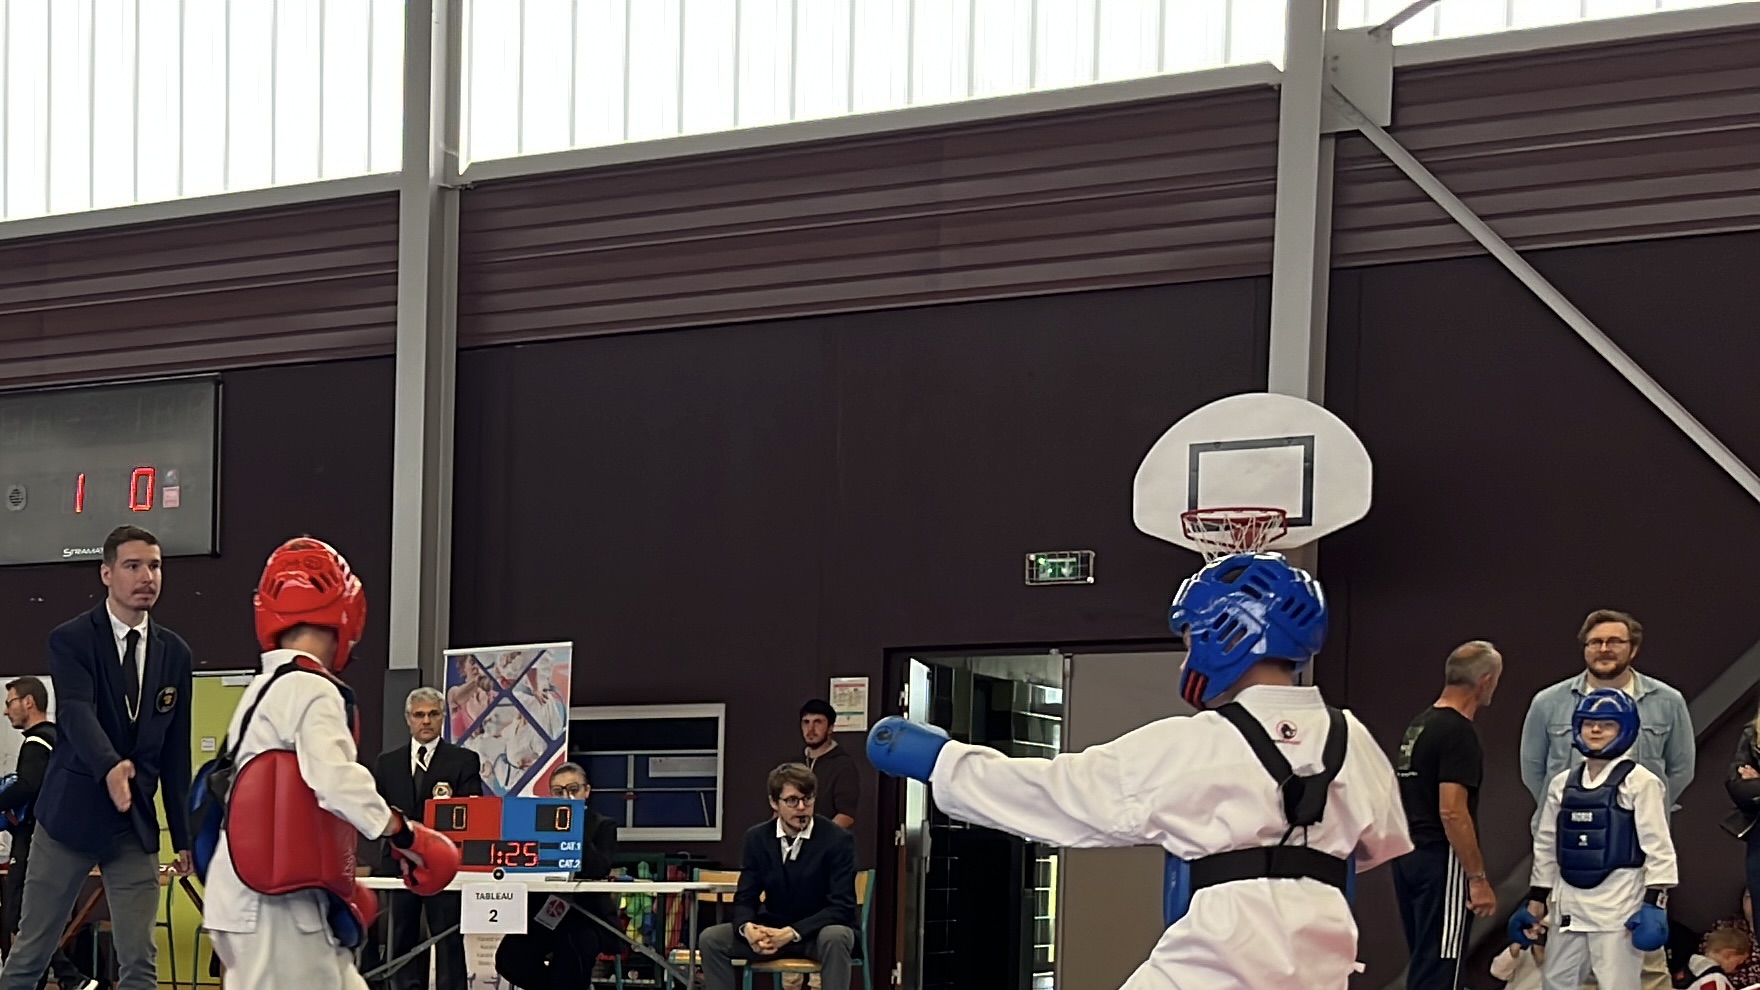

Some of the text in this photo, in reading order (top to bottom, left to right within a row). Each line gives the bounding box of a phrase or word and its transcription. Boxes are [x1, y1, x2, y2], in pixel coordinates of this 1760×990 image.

[129, 467, 155, 511] 0
[452, 805, 467, 830] 0
[555, 806, 571, 831] 0
[490, 842, 539, 867] 1:25
[475, 892, 514, 900] TABLEAU
[488, 909, 499, 922] 2
